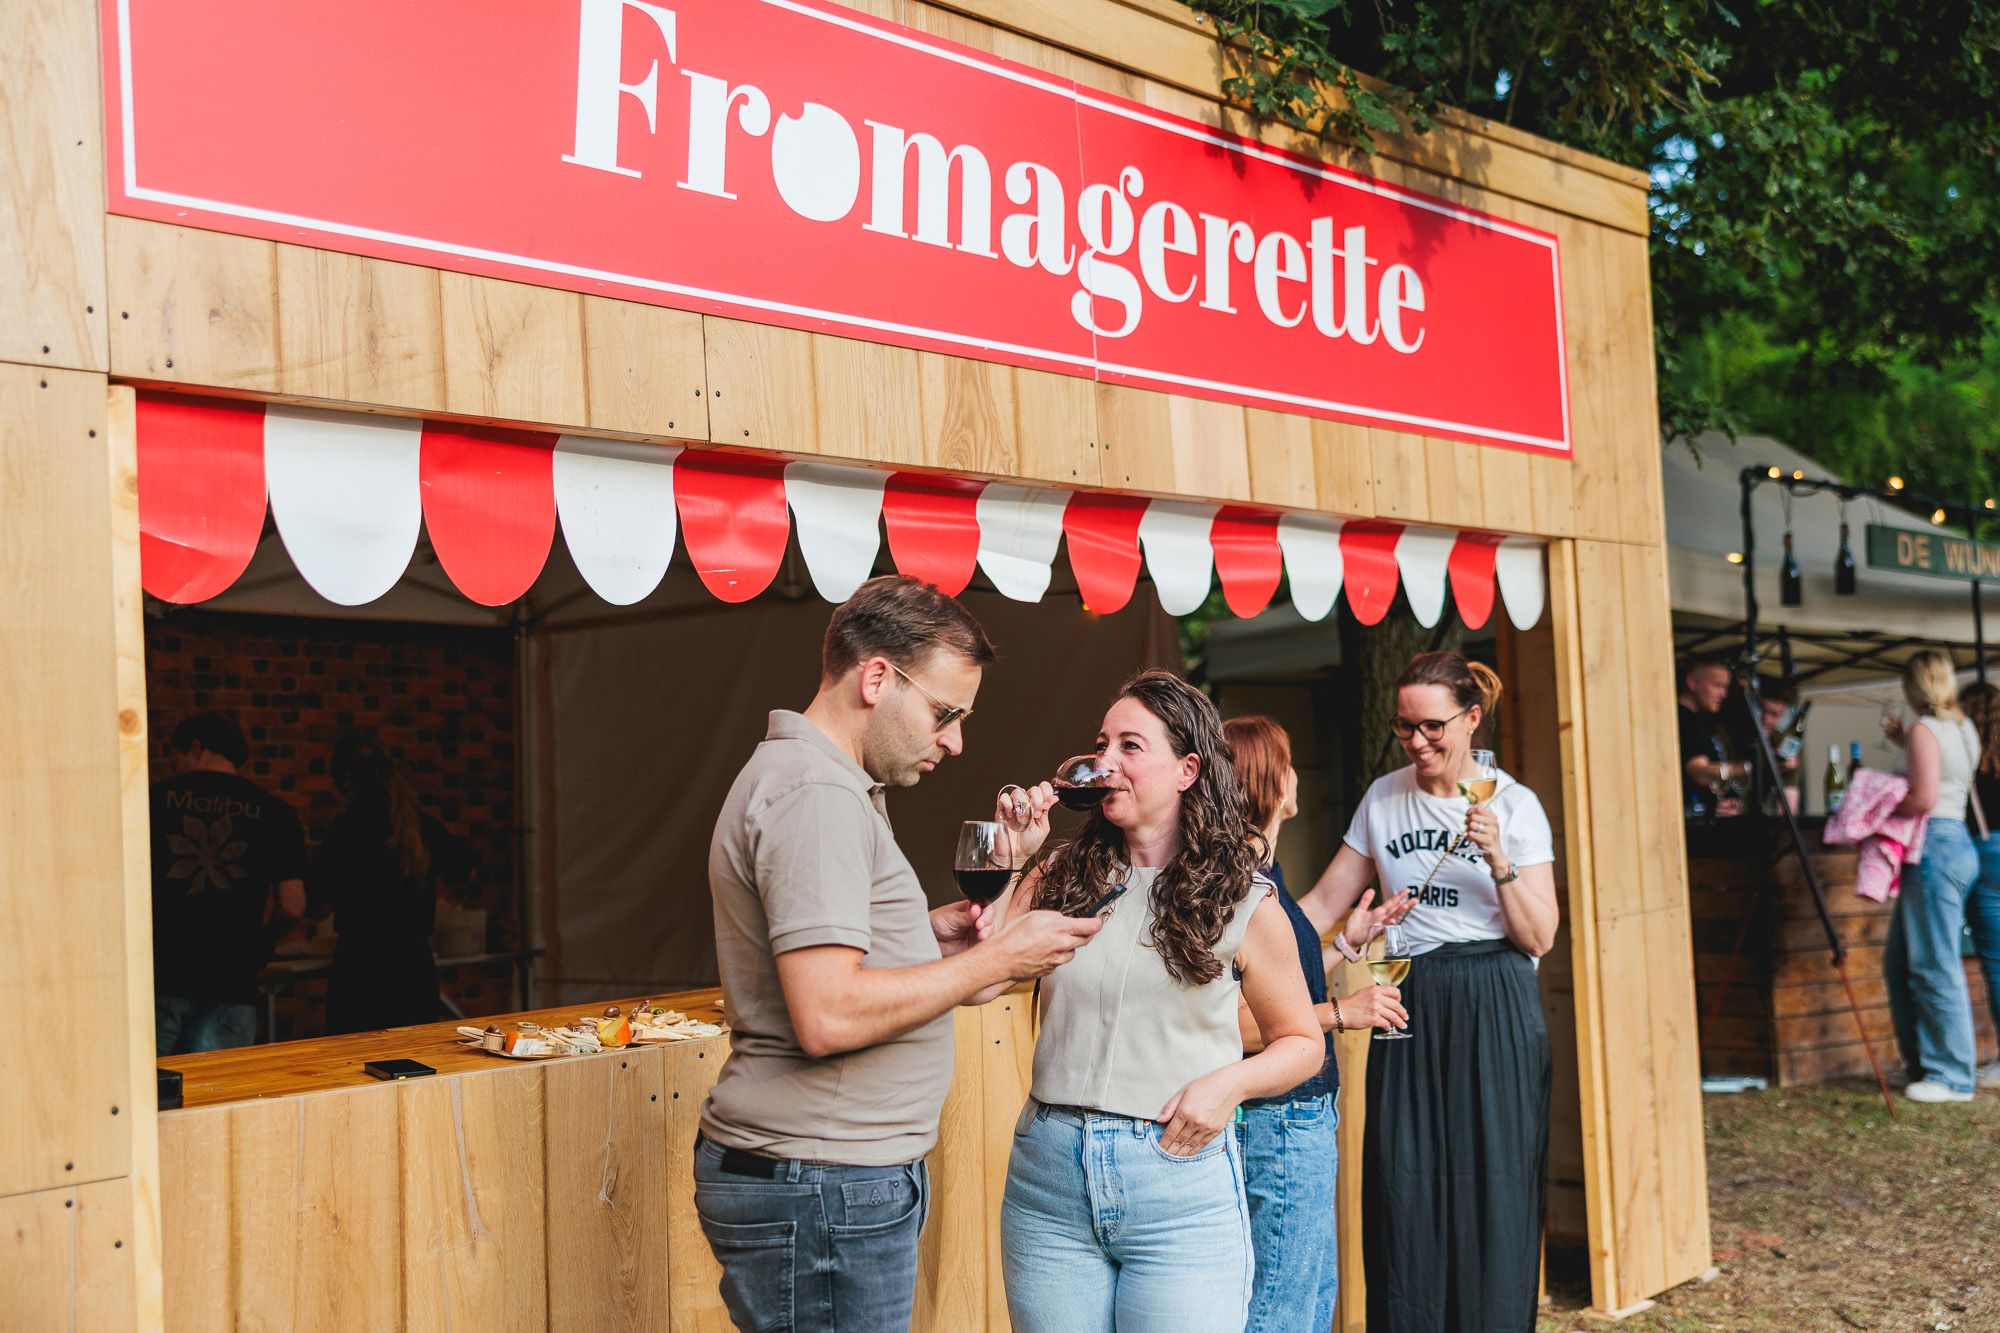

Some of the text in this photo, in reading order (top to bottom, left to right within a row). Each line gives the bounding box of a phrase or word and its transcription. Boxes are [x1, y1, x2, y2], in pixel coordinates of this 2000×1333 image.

[562, 0, 1425, 355] Fromagerette
[1897, 531, 1931, 569] DE
[165, 789, 261, 819] Malibu
[1407, 885, 1458, 907] PARIS
